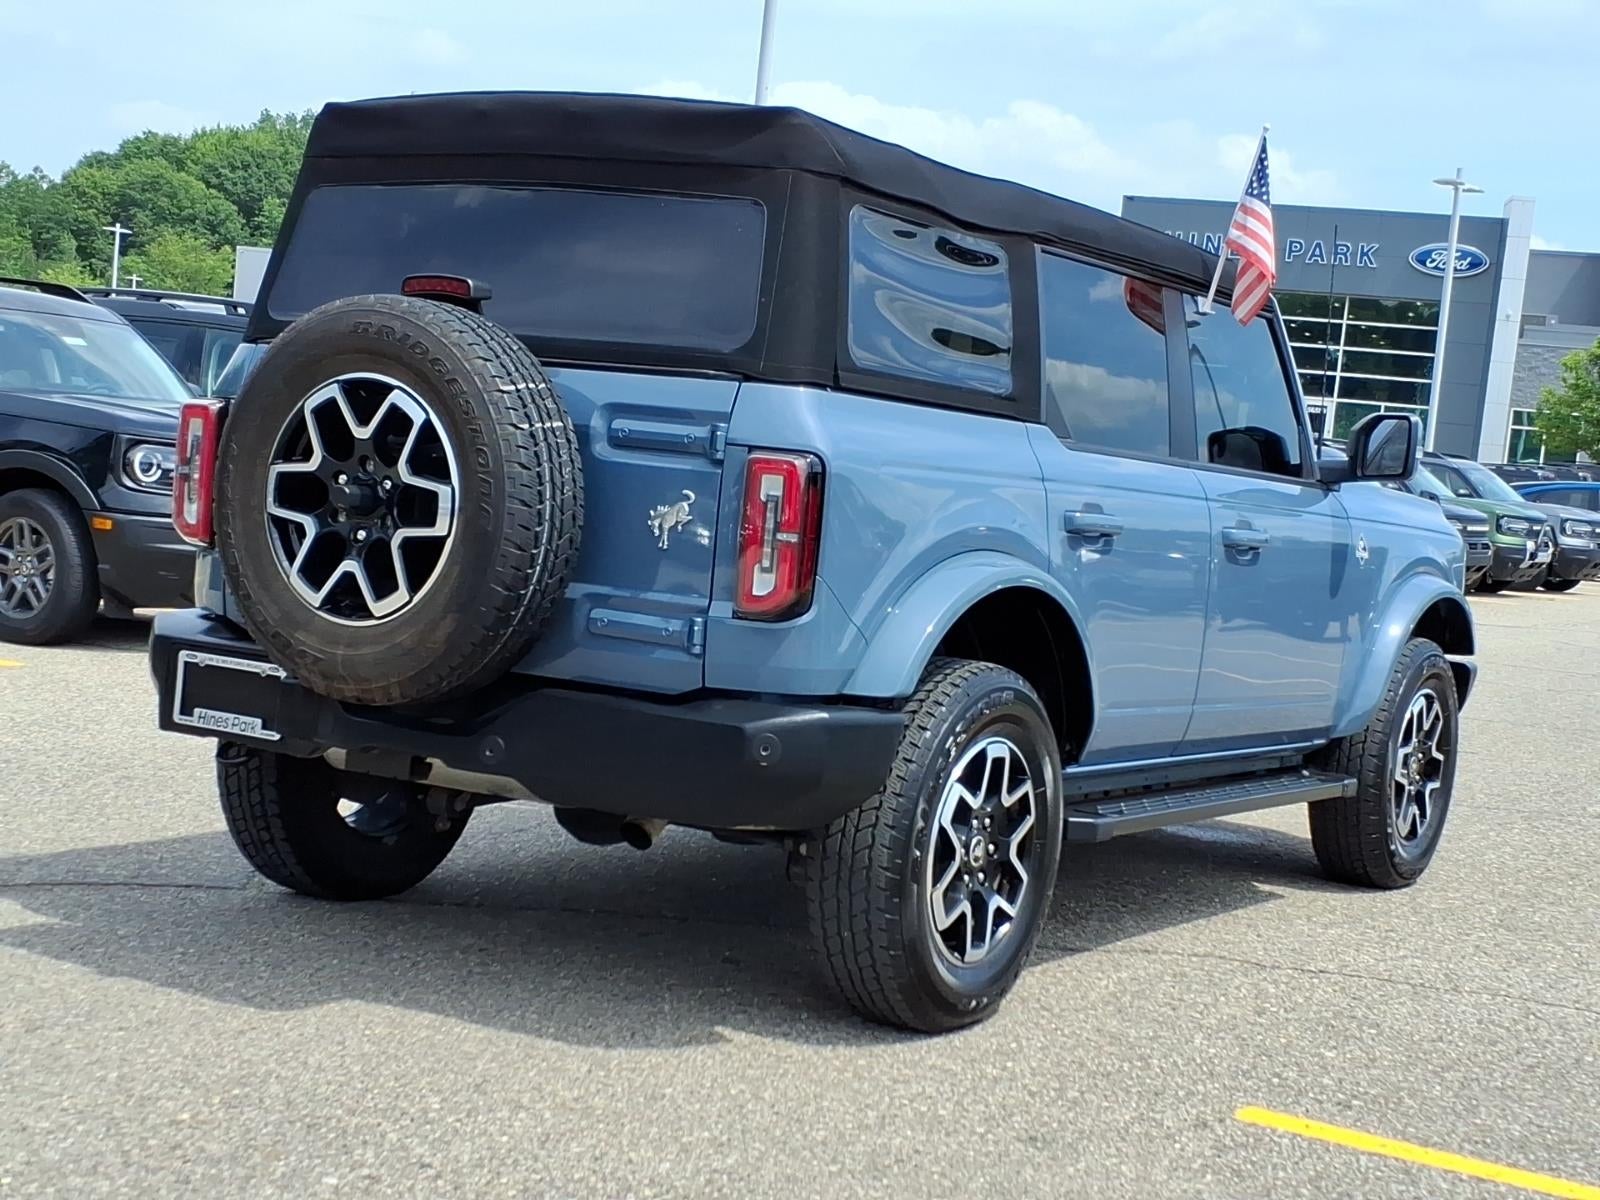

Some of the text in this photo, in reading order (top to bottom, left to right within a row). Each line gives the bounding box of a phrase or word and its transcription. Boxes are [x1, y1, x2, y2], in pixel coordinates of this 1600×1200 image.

[1285, 238, 1379, 267] PARK
[352, 319, 494, 530] BRIDGESTONE
[197, 710, 258, 735] Hines Park
